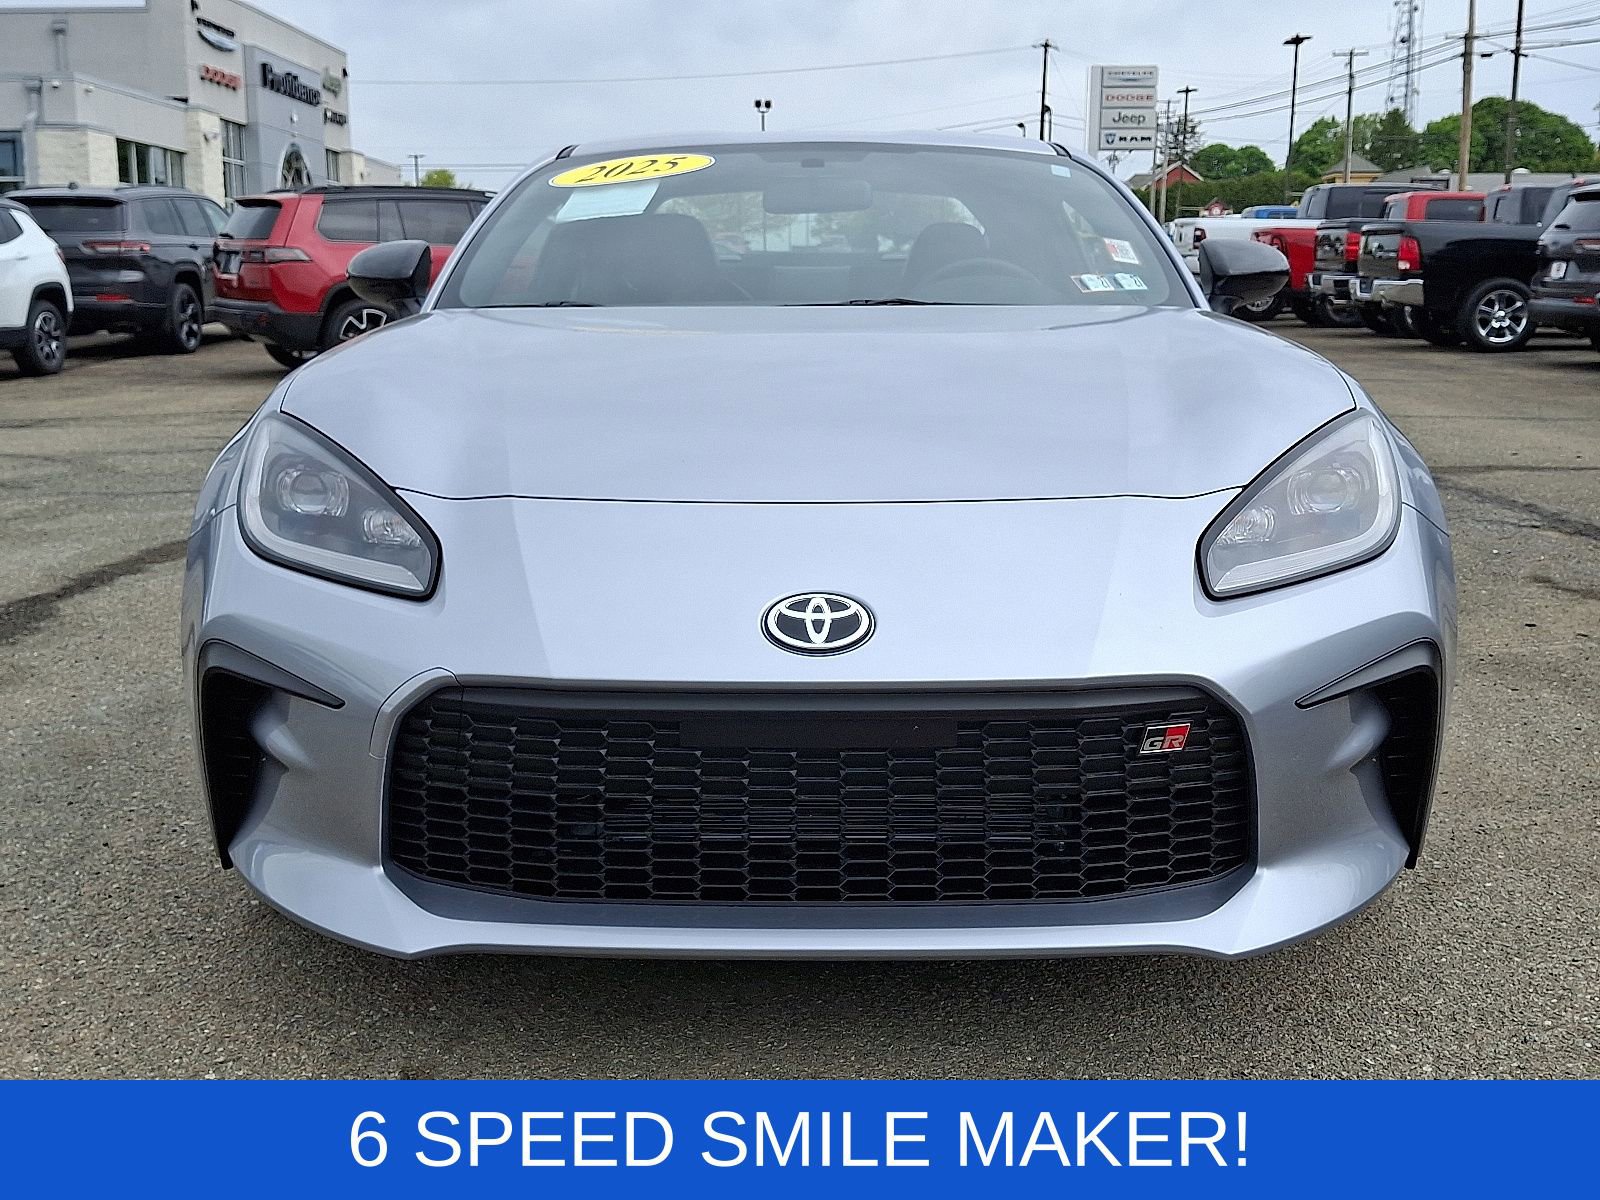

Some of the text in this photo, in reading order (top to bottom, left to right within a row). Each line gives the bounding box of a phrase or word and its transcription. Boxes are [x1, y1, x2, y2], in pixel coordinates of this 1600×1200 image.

[1105, 94, 1154, 102] DODGE
[1112, 111, 1146, 126] Jeep
[575, 156, 688, 184] 2025
[1143, 734, 1185, 751] GR
